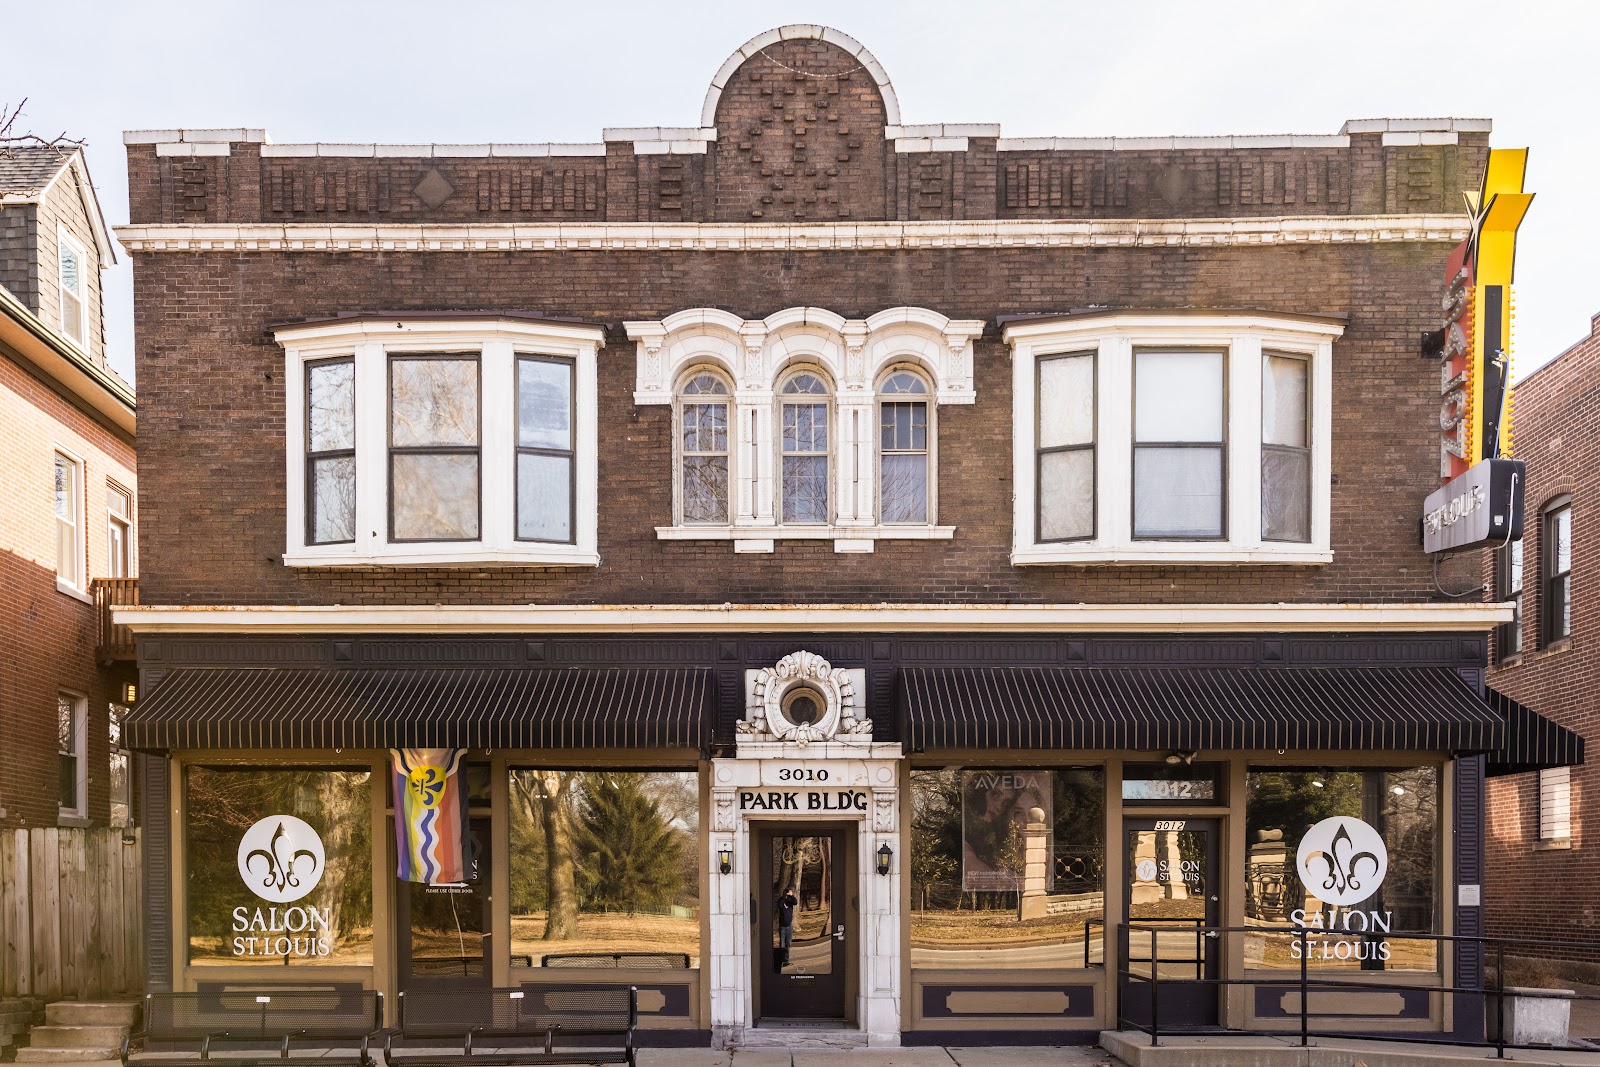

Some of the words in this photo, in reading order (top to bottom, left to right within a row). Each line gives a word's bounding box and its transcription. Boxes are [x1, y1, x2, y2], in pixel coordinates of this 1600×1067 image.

[1440, 267, 1468, 478] SALON
[779, 768, 829, 781] 3010
[974, 775, 1040, 790] AVEDA
[740, 792, 799, 810] PARK
[807, 789, 868, 811] BLD'G
[1156, 821, 1184, 830] 3012
[1159, 860, 1200, 872] SON
[232, 906, 331, 932] SALON
[1290, 908, 1392, 935] SALON
